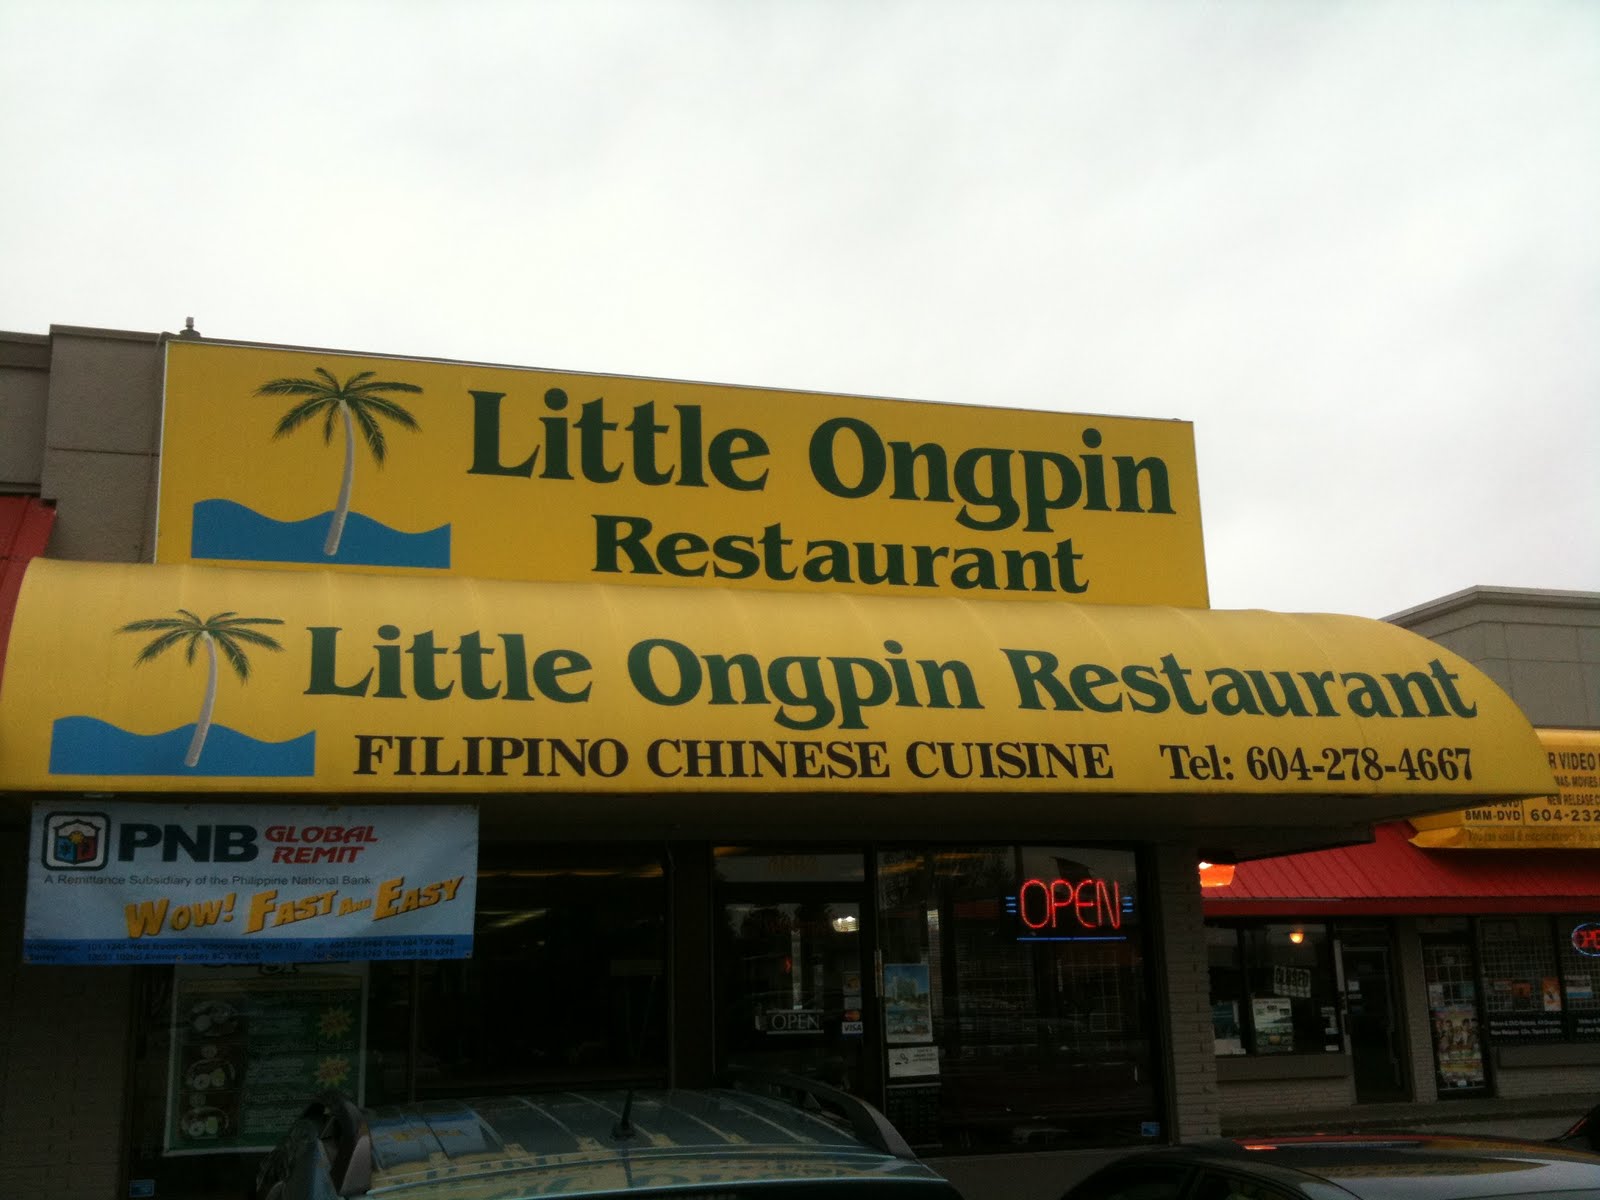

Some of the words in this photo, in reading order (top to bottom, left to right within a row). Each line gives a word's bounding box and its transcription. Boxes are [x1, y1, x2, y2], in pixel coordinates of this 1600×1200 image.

[467, 388, 769, 491] Little
[809, 417, 1176, 532] Ongpin
[592, 508, 1090, 593] Restaurant
[304, 625, 592, 703] Little
[628, 639, 985, 731] Ongpin
[1001, 648, 1477, 718] Restaurant
[353, 735, 628, 777] FILIPINO
[647, 739, 890, 778] CHINESE
[906, 741, 1113, 778] CUISINE
[1160, 745, 1233, 780] Tel:
[1247, 747, 1472, 781] 604-278-4667
[1559, 752, 1596, 771] VIDEO
[1563, 793, 1592, 807] RELEASE
[1465, 810, 1521, 821] 8MM-DVD
[118, 823, 259, 863] PNB
[264, 825, 379, 843] GLOBAL
[272, 846, 365, 864] REMIT
[43, 874, 54, 885] A
[57, 874, 126, 885] Remittance
[129, 875, 192, 888] Subsidiary
[195, 875, 207, 886] of
[210, 875, 229, 886] the
[232, 875, 288, 888] Philippine
[292, 875, 339, 886] National
[342, 875, 371, 886] Bank
[1020, 879, 1121, 929] OPEN
[771, 1014, 820, 1030] OPEN
[844, 1023, 863, 1033] VISA
